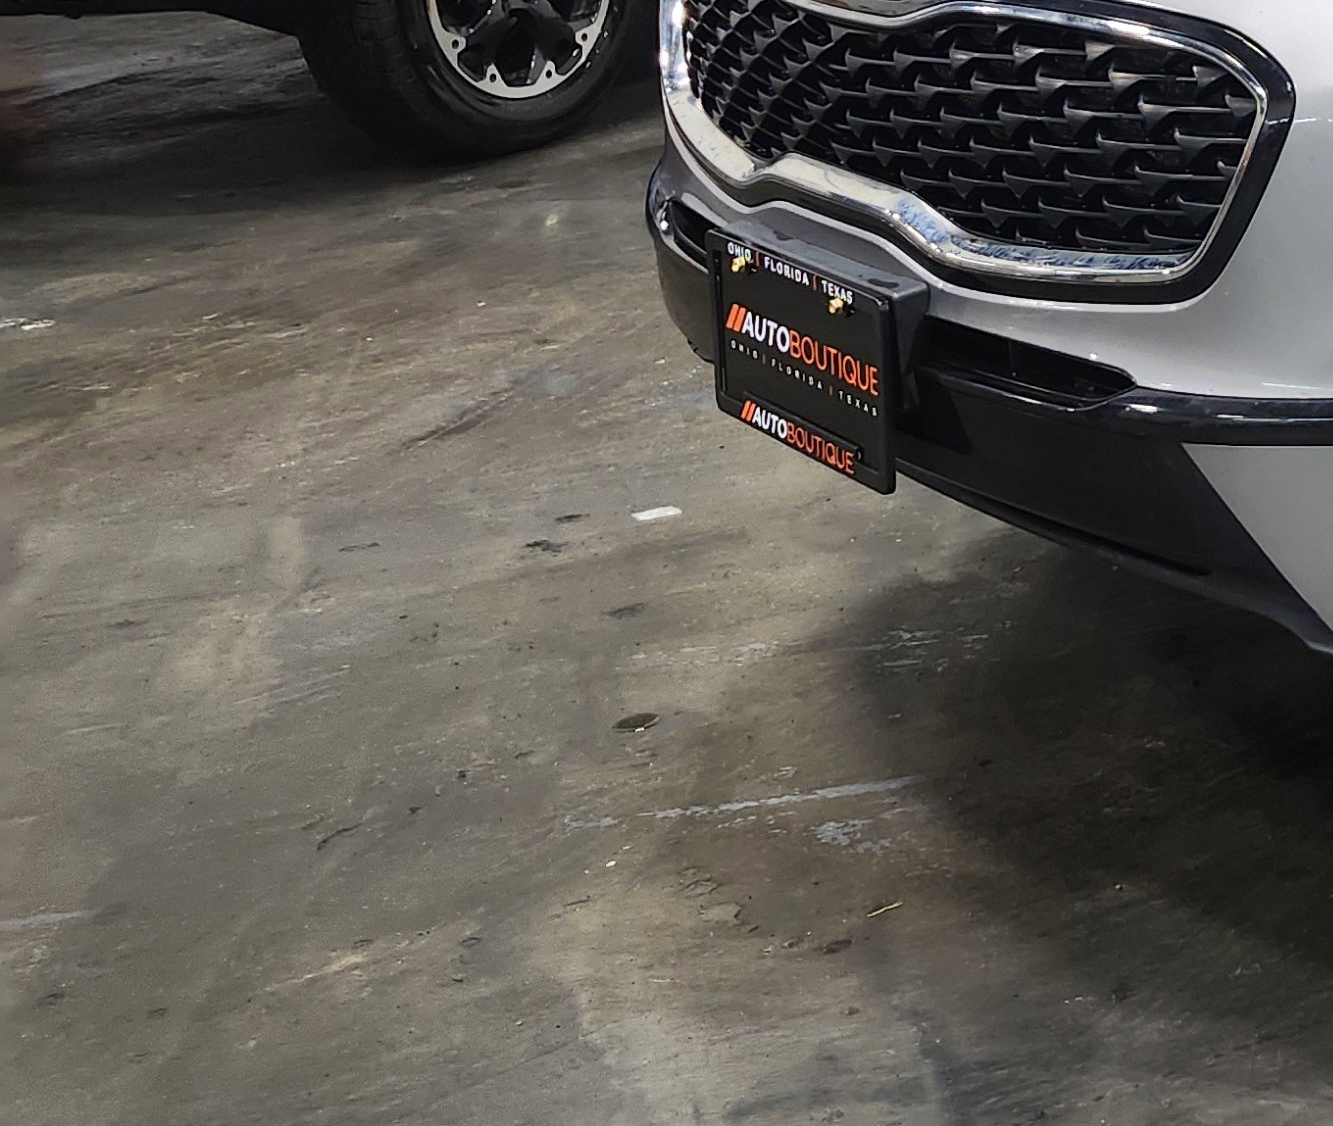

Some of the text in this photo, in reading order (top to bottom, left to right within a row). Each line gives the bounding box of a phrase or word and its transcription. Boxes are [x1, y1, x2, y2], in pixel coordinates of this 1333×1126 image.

[727, 242, 853, 305] OHIO FLORIDA TEXAS
[731, 340, 878, 416] OHIO FLORIDA TEXAS
[741, 311, 879, 396] AUTOBOUTIQUE
[752, 406, 854, 474] AUTOBOUTIQUE
